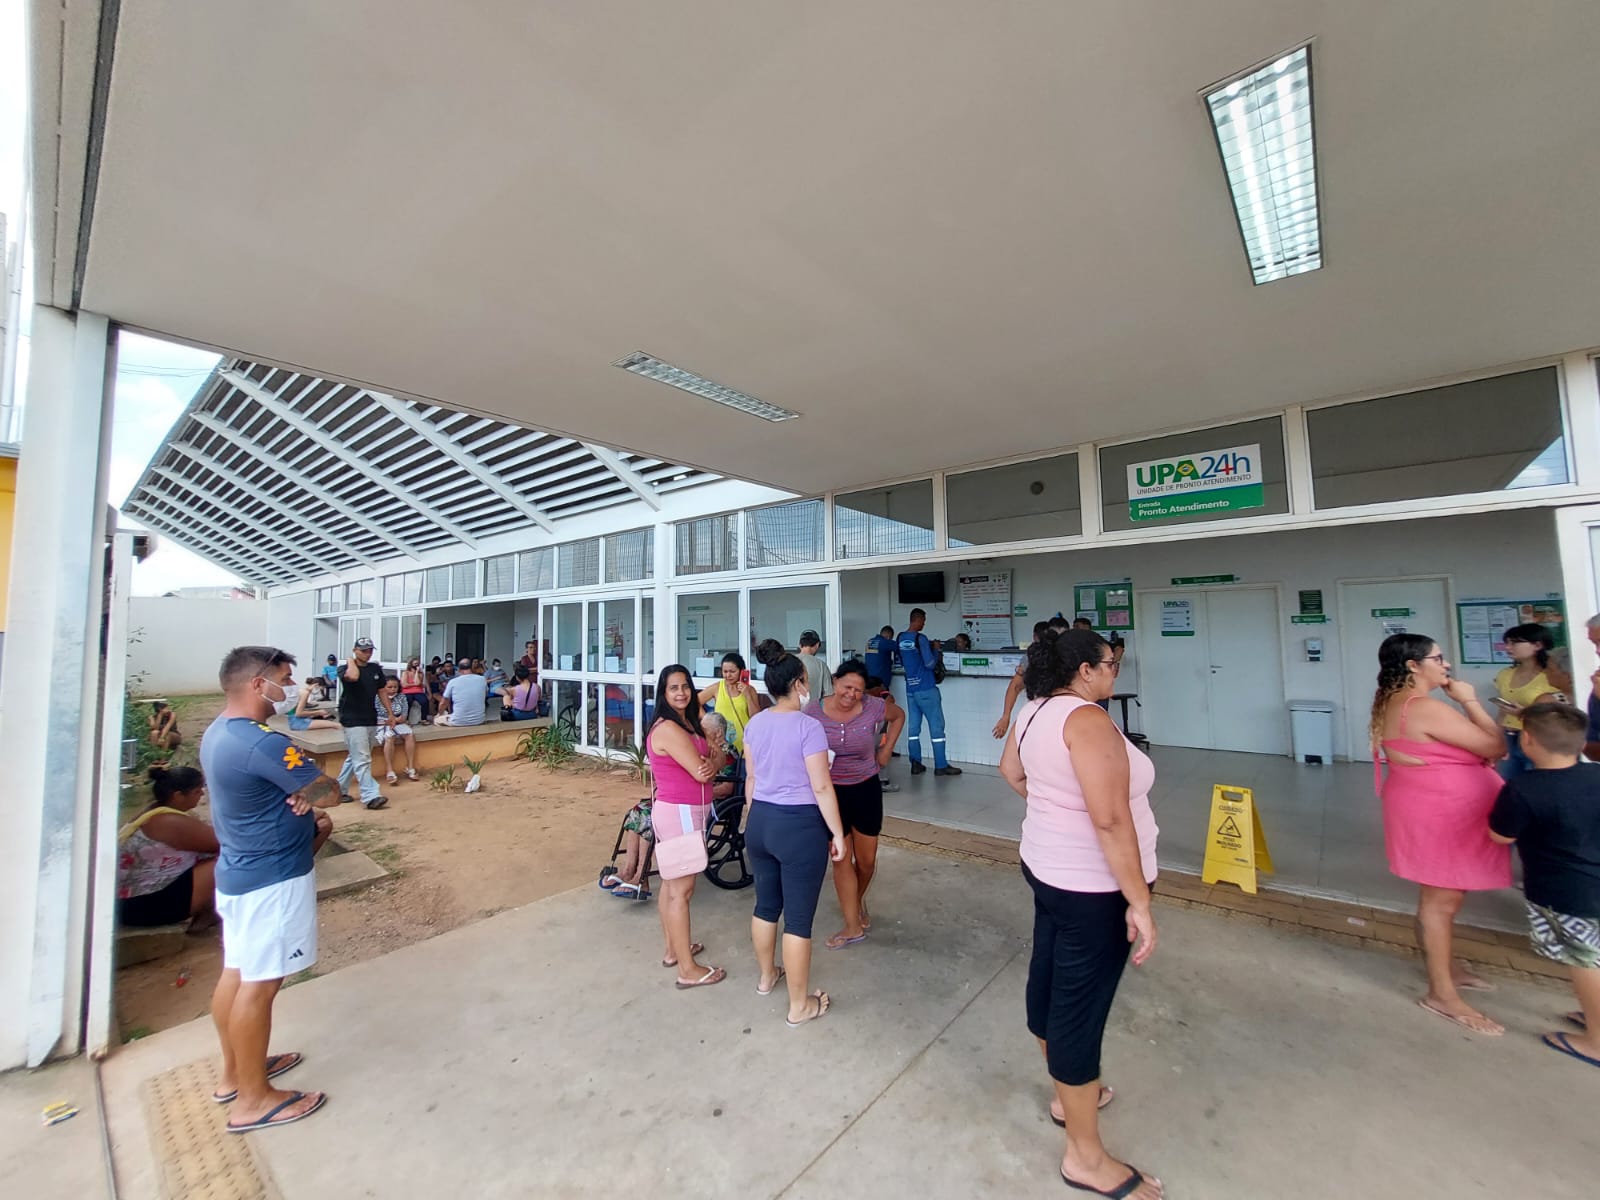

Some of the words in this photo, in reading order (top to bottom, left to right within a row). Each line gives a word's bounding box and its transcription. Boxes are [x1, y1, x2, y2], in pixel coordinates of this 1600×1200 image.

[1136, 460, 1199, 487] UPA
[1137, 486, 1165, 495] UNIDADE
[1175, 481, 1202, 490] PRONTO
[1203, 474, 1251, 486] ATENDIMENTO
[1138, 507, 1168, 517] Pronto
[1168, 500, 1230, 513] Atendimento
